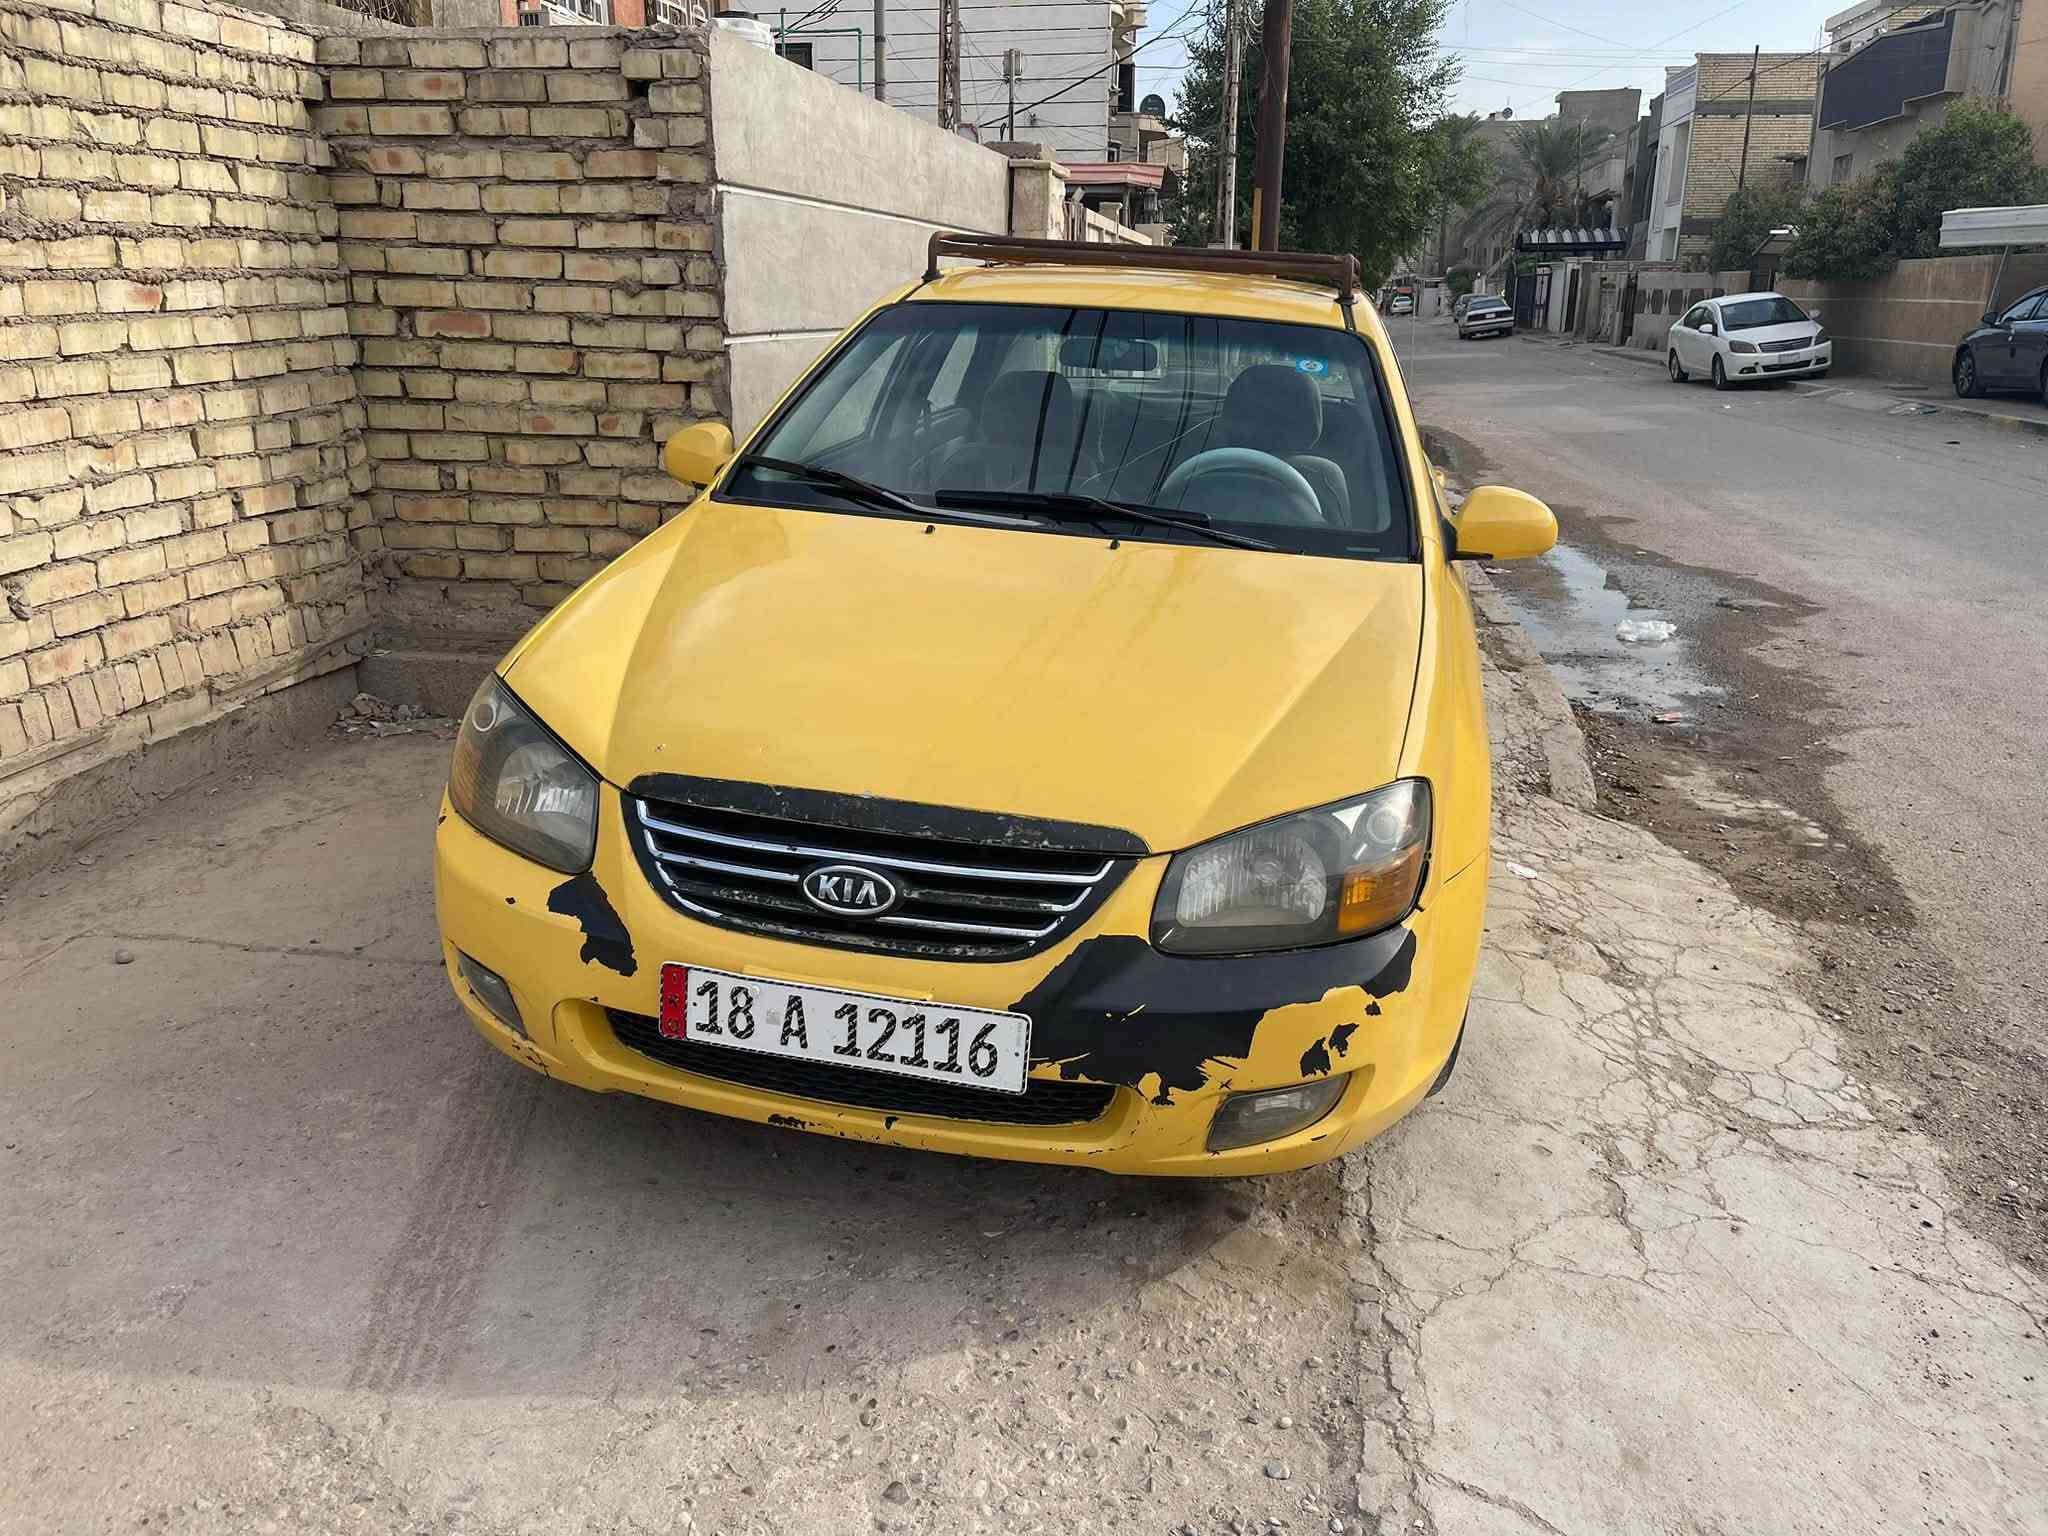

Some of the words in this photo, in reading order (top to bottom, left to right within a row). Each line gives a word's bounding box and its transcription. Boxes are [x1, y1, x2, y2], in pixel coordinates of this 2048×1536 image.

[818, 875, 878, 906] KIA
[696, 980, 755, 1039] 18
[780, 995, 809, 1049] A
[833, 1003, 998, 1078] 12116
